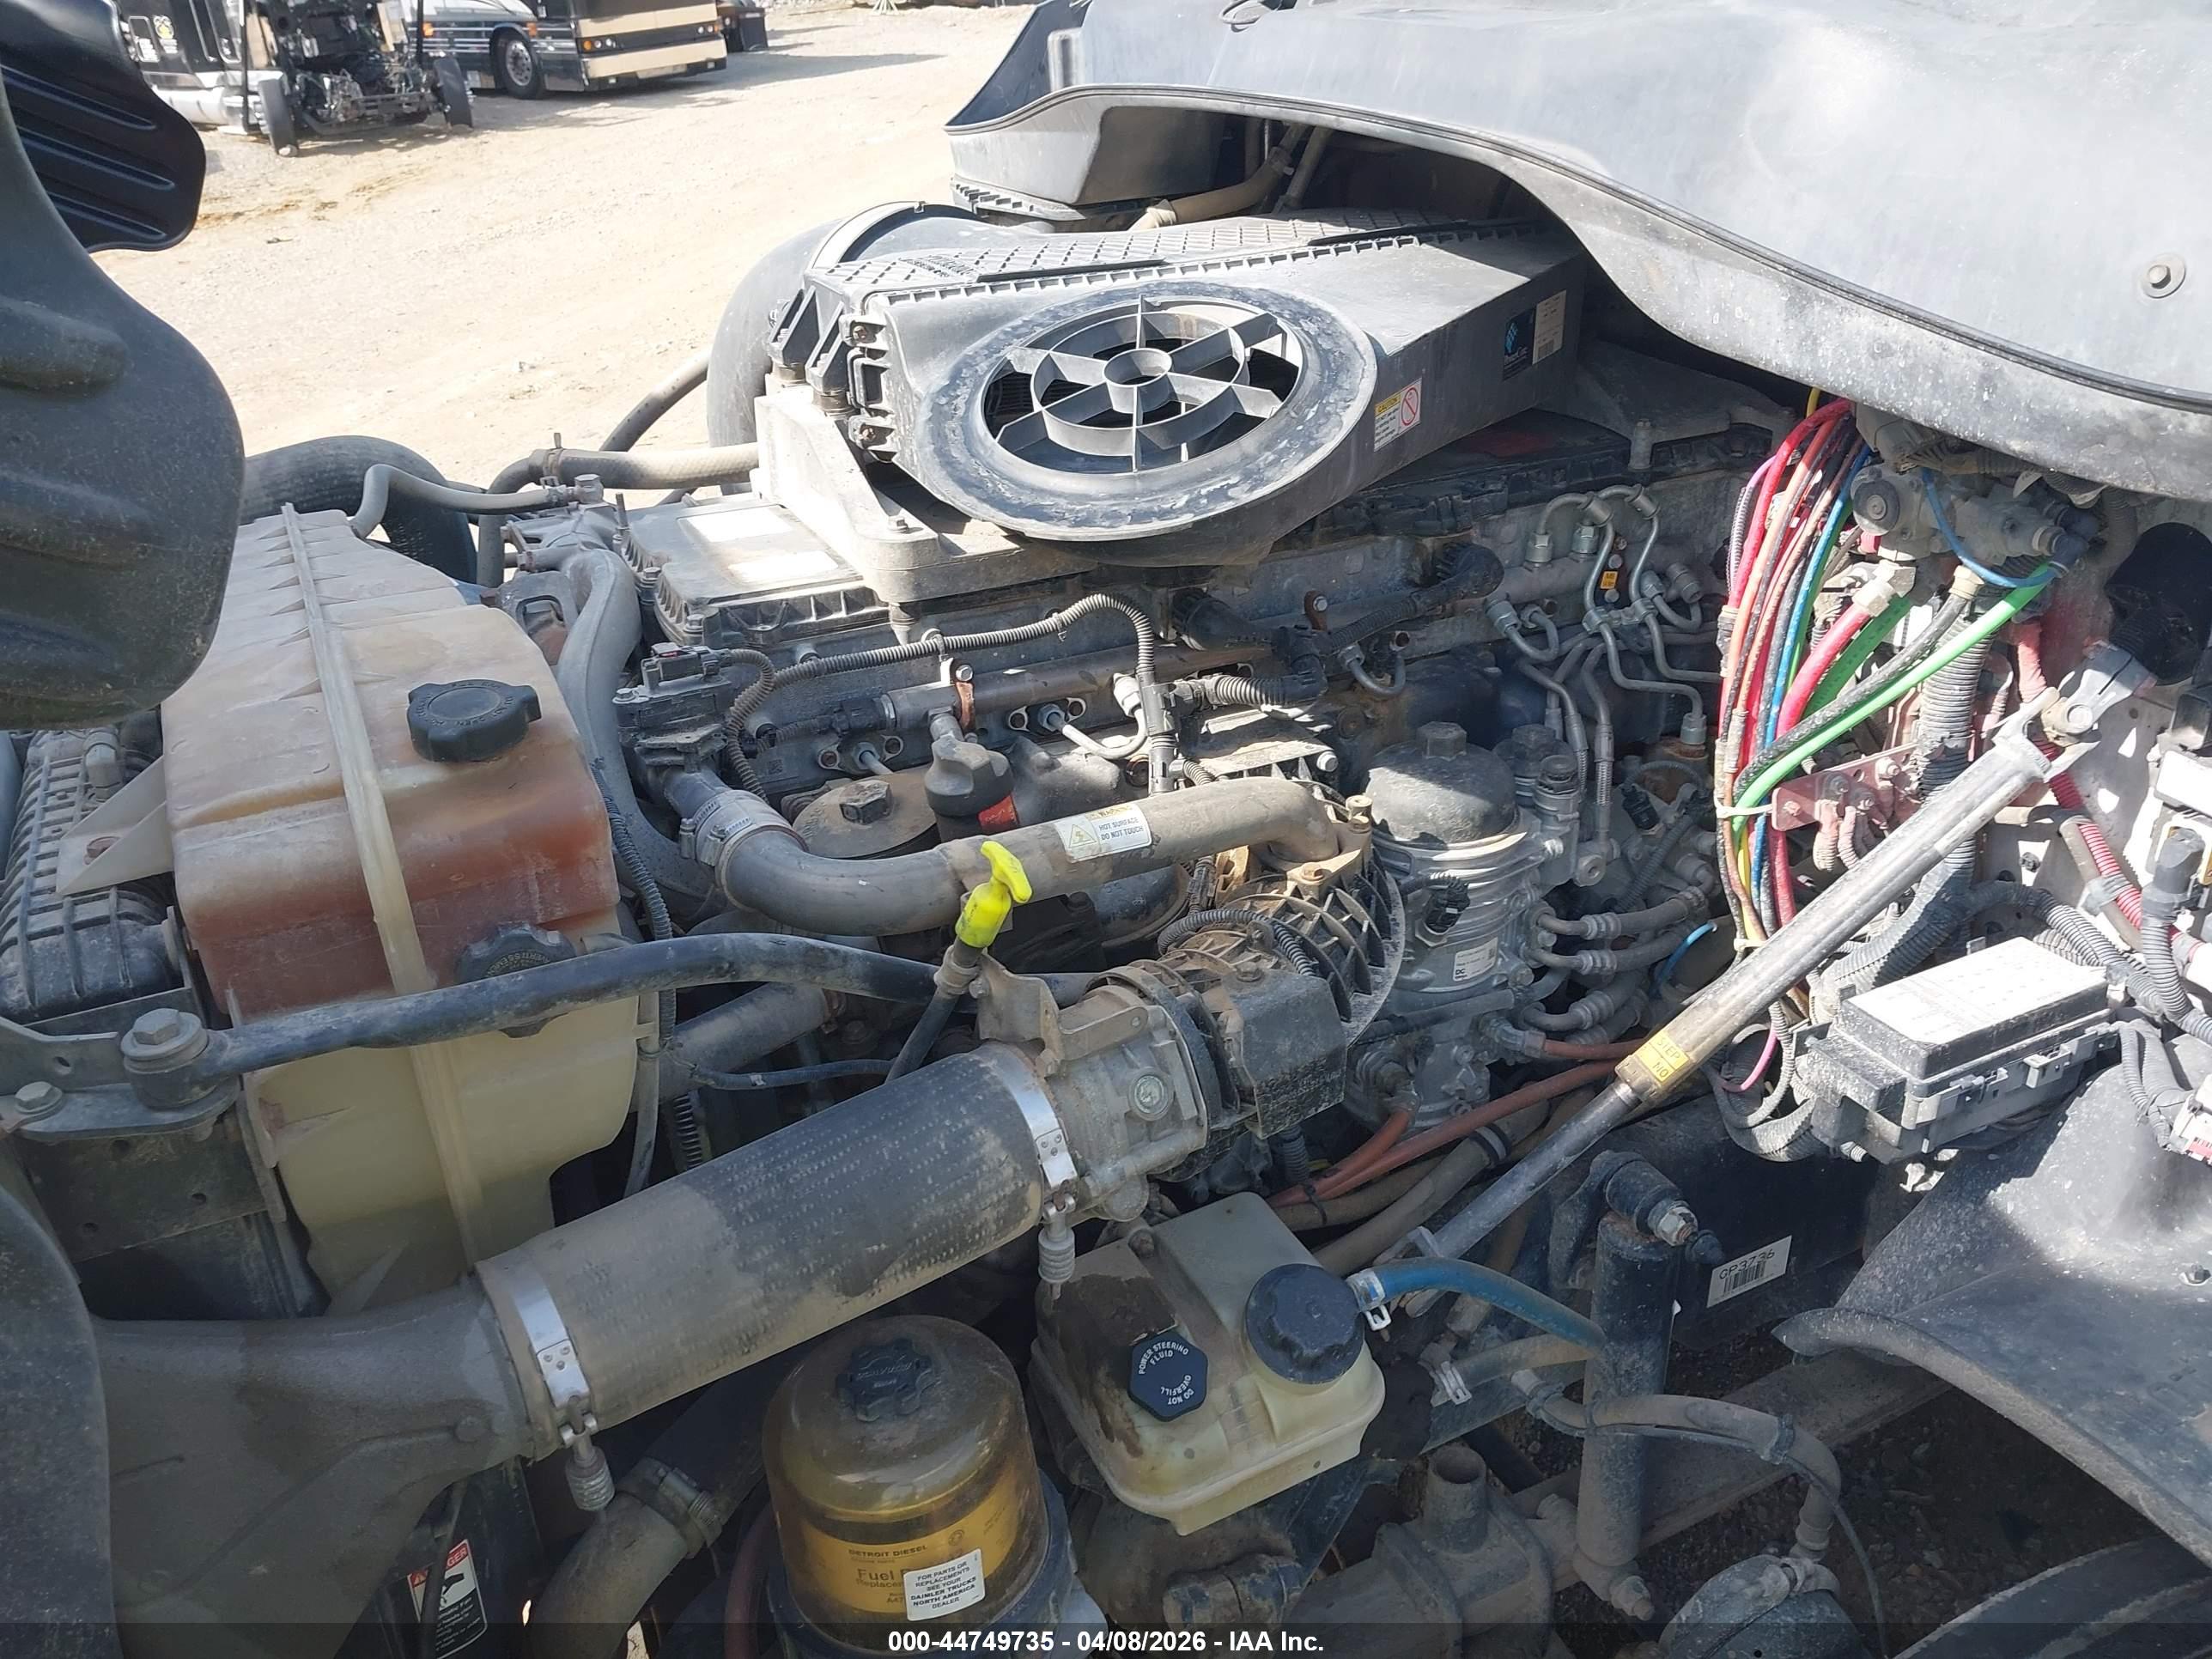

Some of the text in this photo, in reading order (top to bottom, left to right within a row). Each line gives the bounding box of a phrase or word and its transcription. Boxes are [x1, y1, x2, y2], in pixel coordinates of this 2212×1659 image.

[1099, 817, 1139, 831] HOT SURFACE
[1112, 830, 1123, 838] NOT
[1124, 825, 1145, 836] TOUCH
[1657, 1036, 1681, 1059] STEP
[1652, 1061, 1669, 1078] NO
[1138, 1341, 1189, 1375] POWER STEERING
[1149, 1349, 1174, 1366] FLUID
[1161, 1375, 1192, 1396] OVERFILL
[1167, 1388, 1194, 1405] DO NOT
[447, 1547, 467, 1567] GER
[848, 1545, 927, 1558] DETROIT DIESEL
[858, 1568, 895, 1581] Fuel
[915, 1566, 970, 1587] REPLACEMENTS
[933, 1566, 957, 1578] PARTS
[957, 1561, 968, 1570] OR
[911, 1577, 977, 1600] DAIMLER TRUCKS
[942, 1577, 962, 1588] YOUR
[913, 1597, 941, 1607] NORTH
[942, 1583, 976, 1600] AMERICA
[932, 1597, 960, 1609] DEALER
